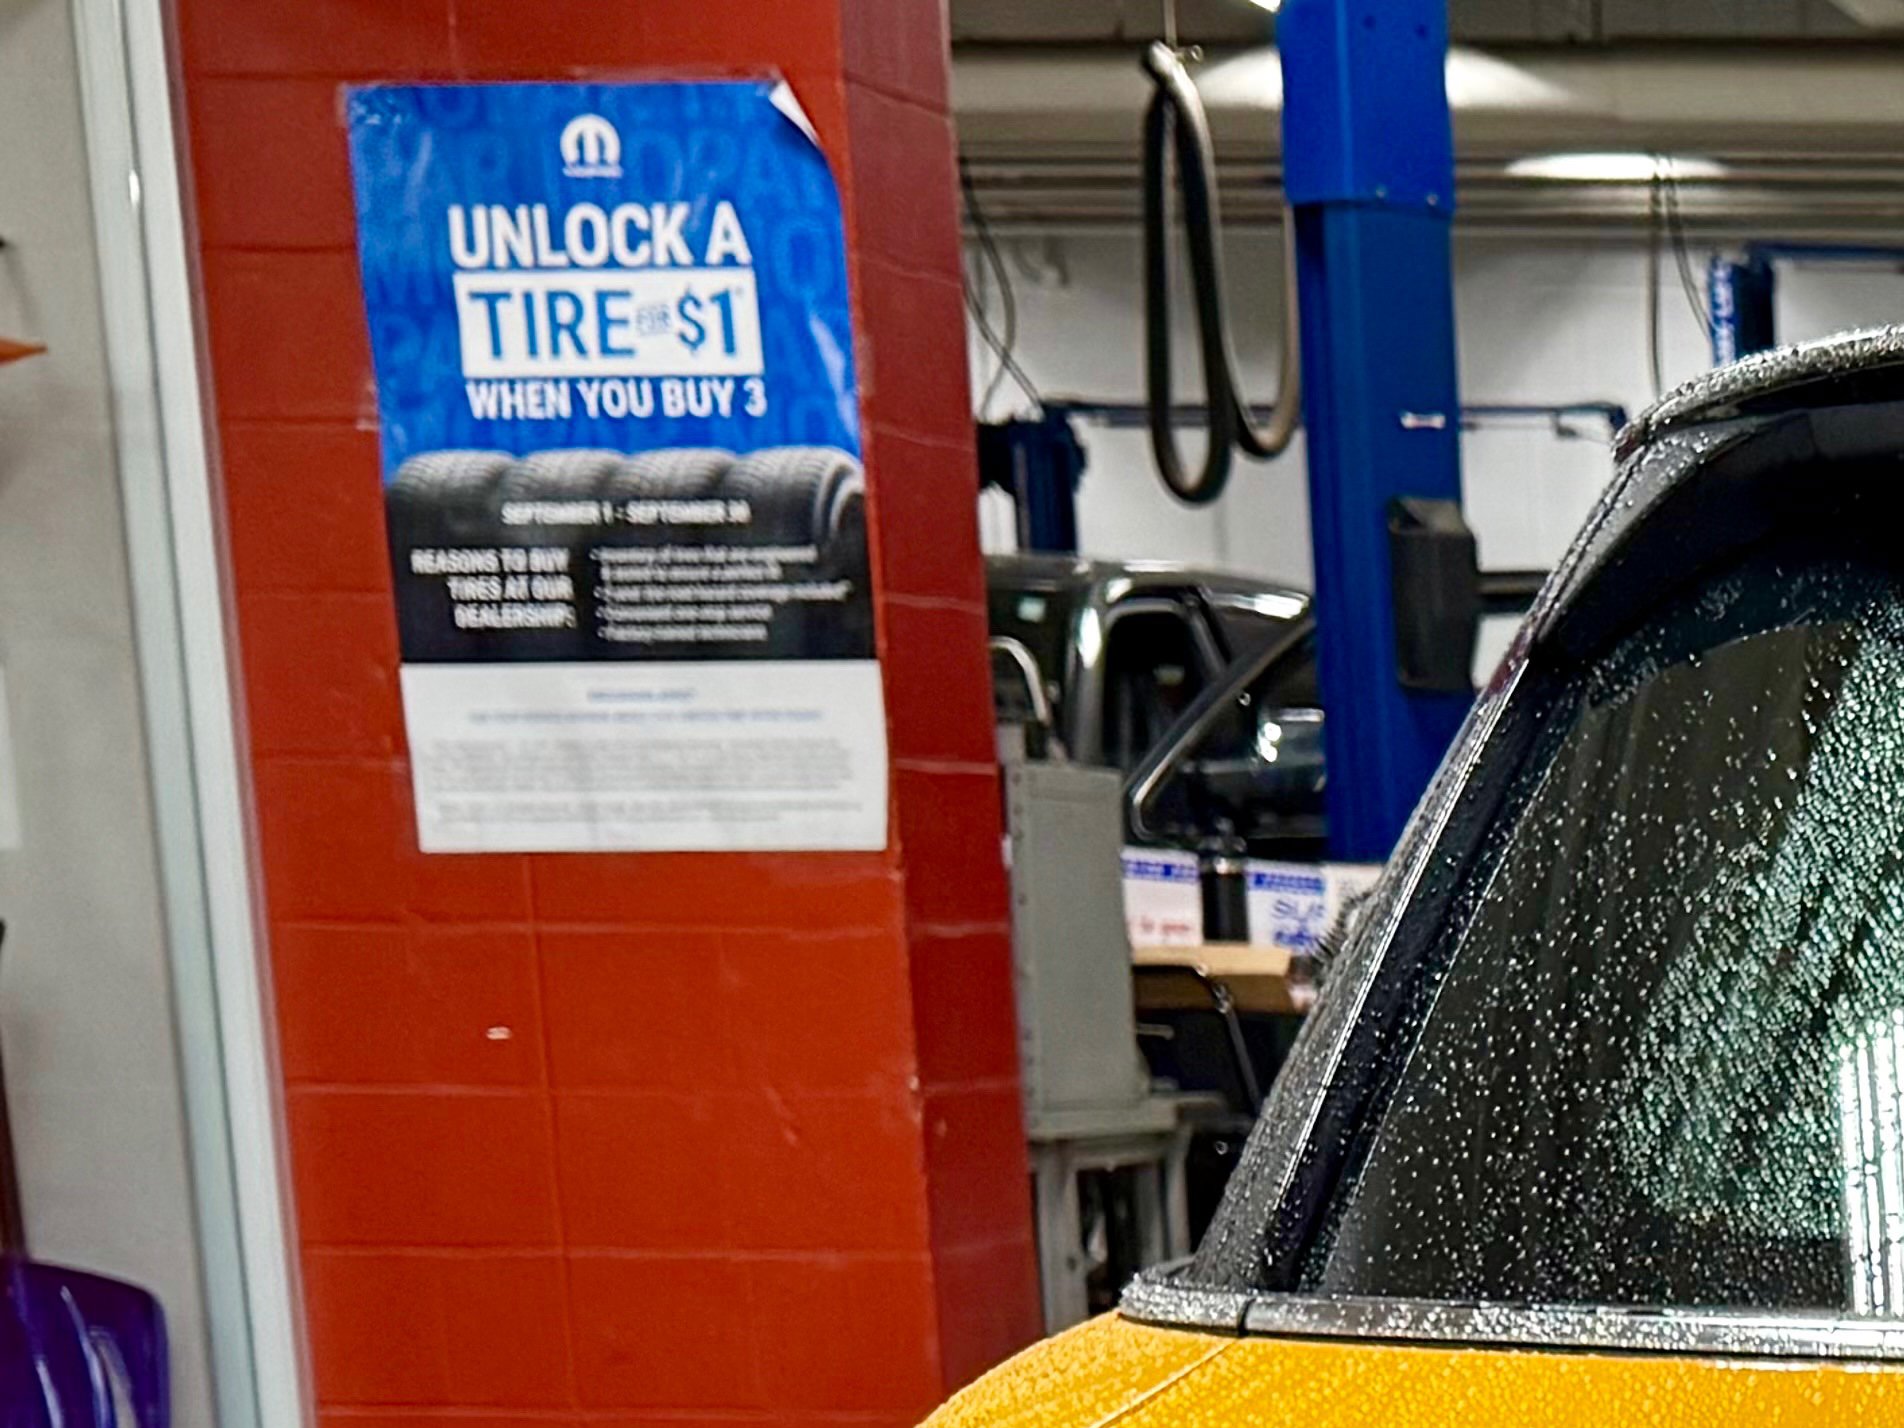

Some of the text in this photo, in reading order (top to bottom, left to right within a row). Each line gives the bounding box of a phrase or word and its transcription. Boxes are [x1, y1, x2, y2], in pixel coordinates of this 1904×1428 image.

[447, 200, 752, 268] UNLOCK A
[467, 290, 634, 360] TIRE
[465, 379, 767, 421] WHEN YOU BUY 3
[410, 547, 500, 575] REASONS
[500, 547, 528, 573] TO
[529, 547, 569, 573] BUY
[446, 573, 503, 601] TIRES
[503, 573, 529, 601] AT
